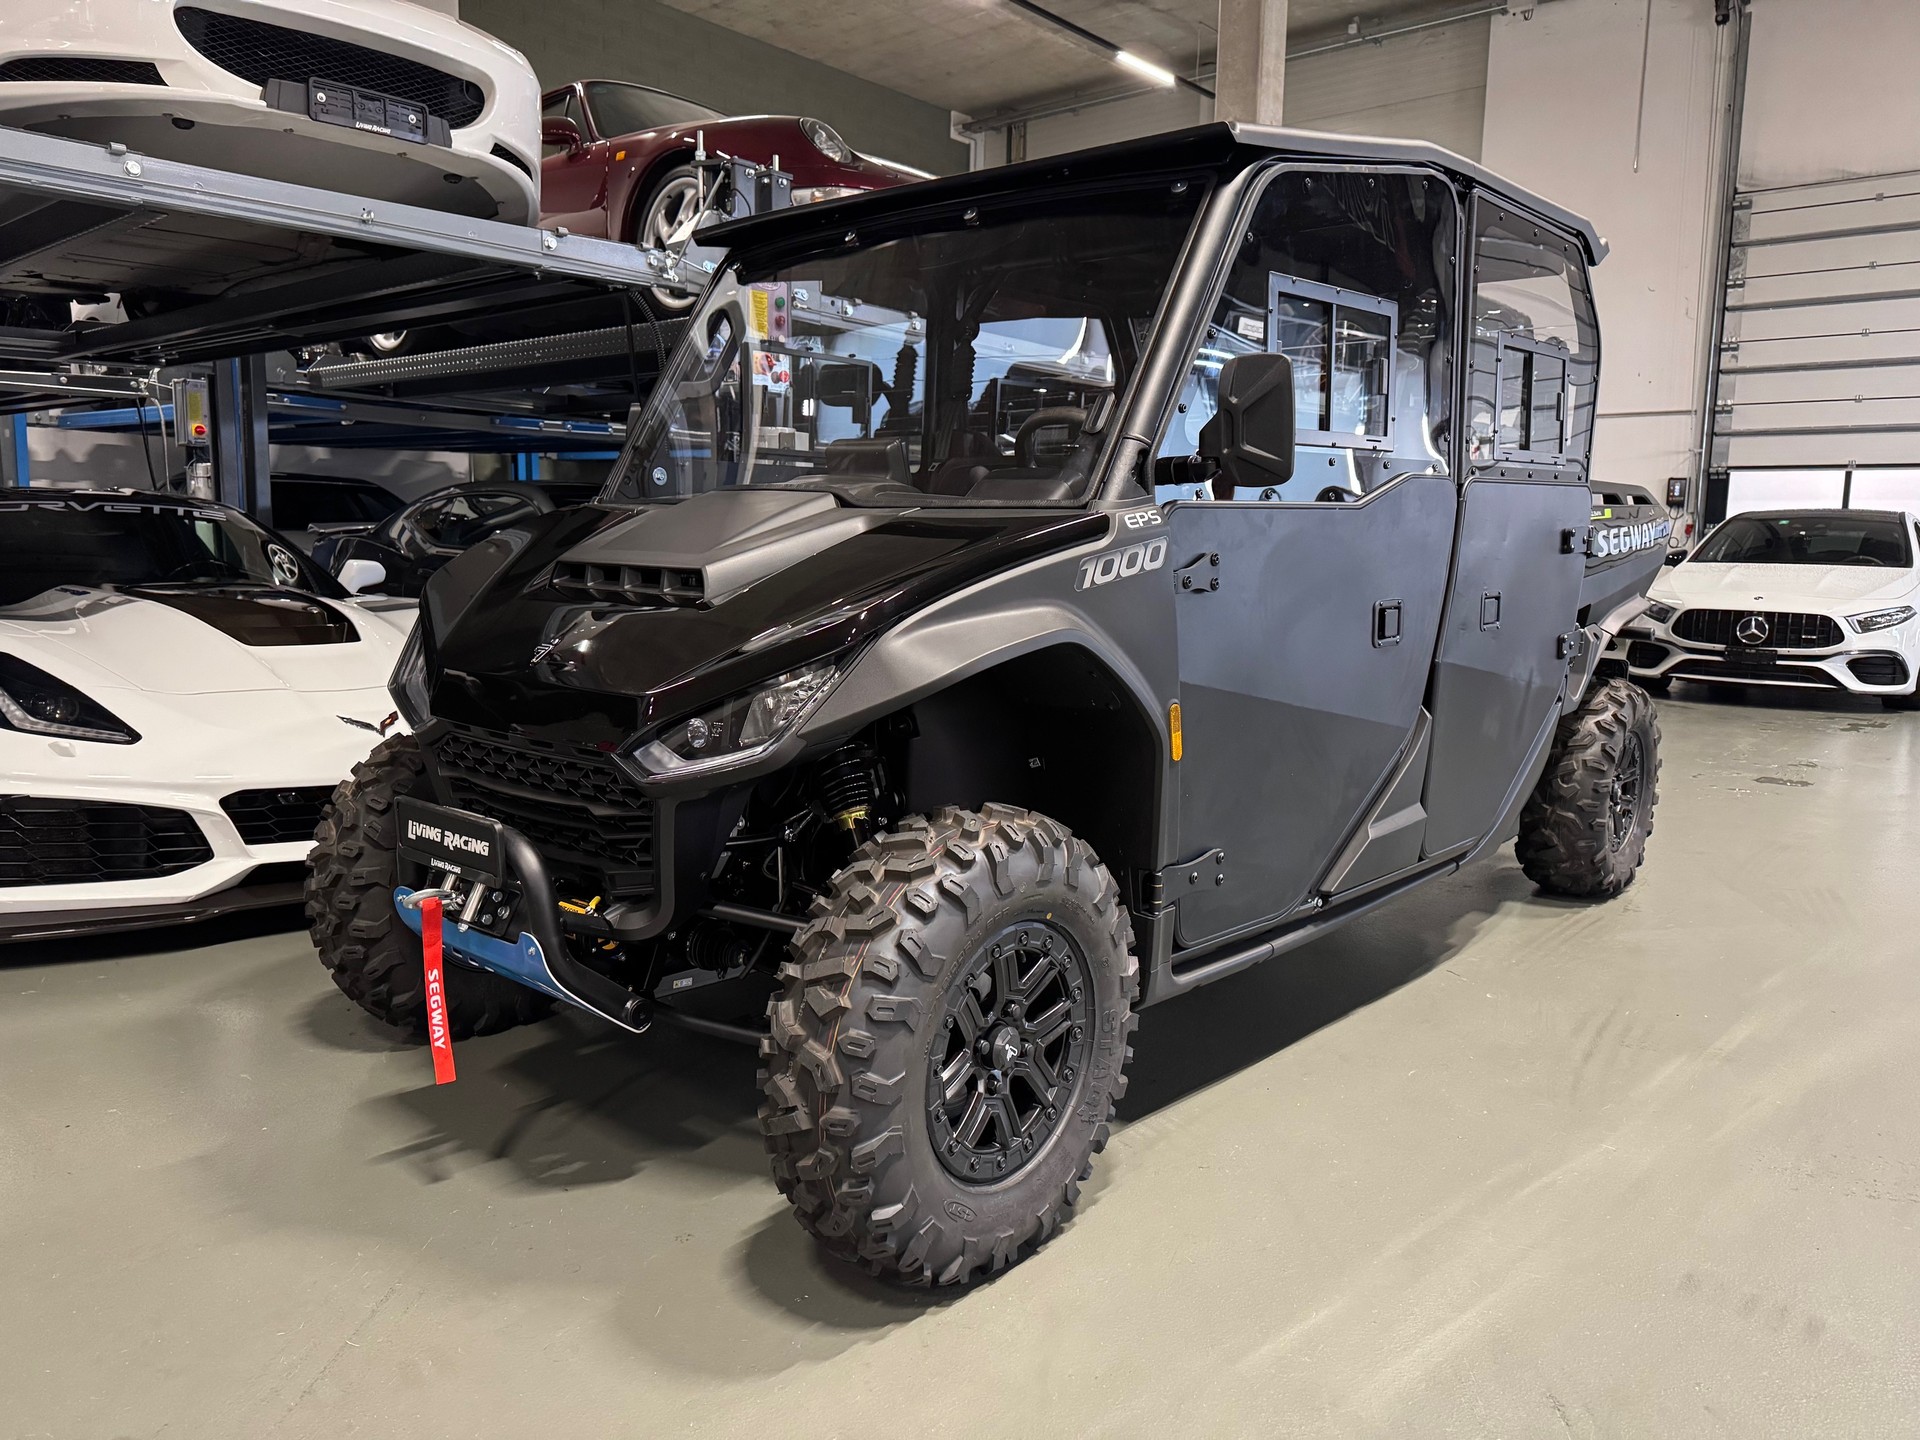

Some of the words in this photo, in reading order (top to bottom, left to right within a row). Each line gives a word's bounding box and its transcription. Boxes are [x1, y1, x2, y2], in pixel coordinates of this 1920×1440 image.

[1124, 510, 1161, 529] EPS
[1597, 521, 1656, 558] SEGWAY
[1080, 539, 1168, 589] 1000
[428, 968, 446, 1049] SEGWAY
